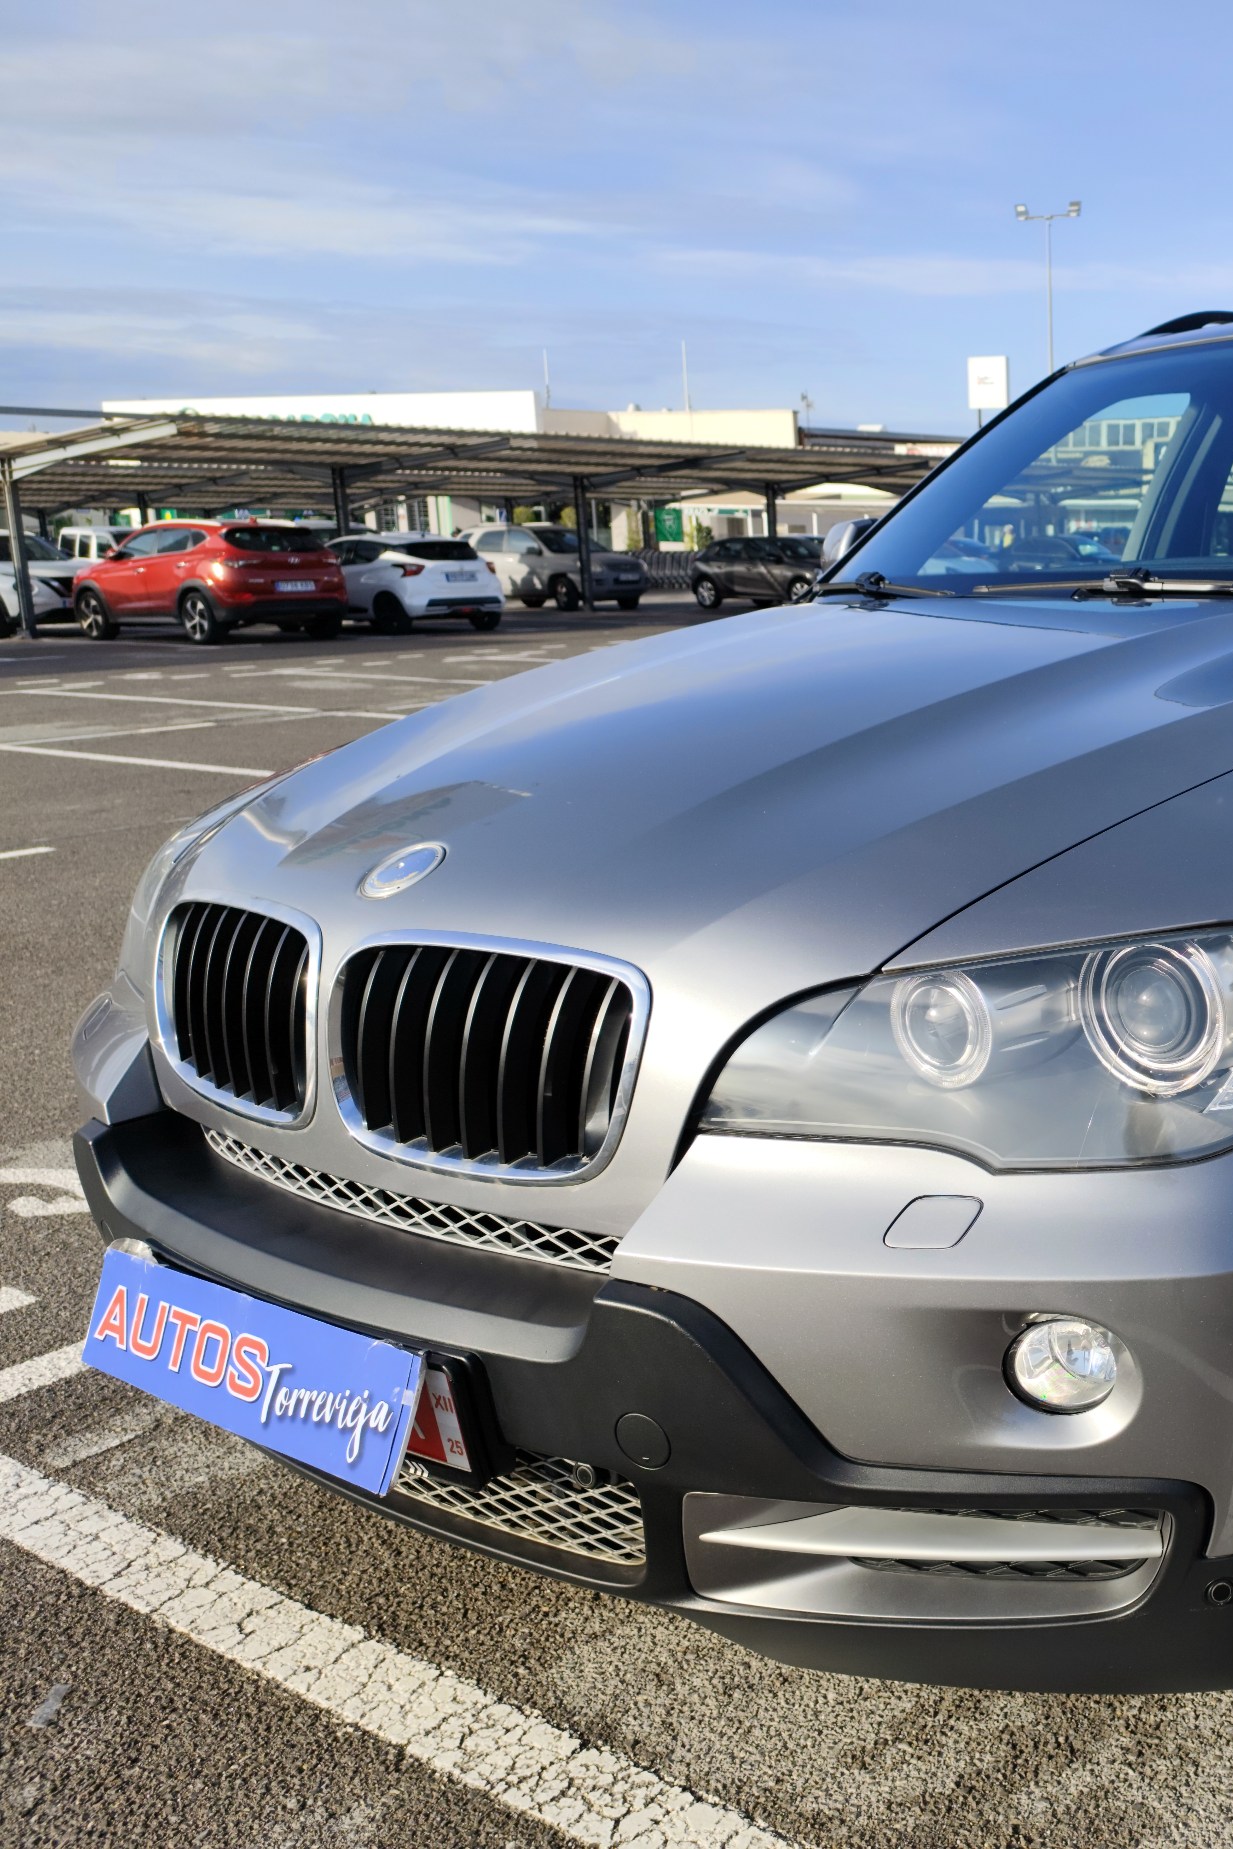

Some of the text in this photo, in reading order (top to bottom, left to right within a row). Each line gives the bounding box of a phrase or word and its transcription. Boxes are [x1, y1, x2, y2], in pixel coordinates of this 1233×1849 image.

[94, 1285, 395, 1463] AUTOS Torrevieja
[447, 1437, 464, 1457] 25
